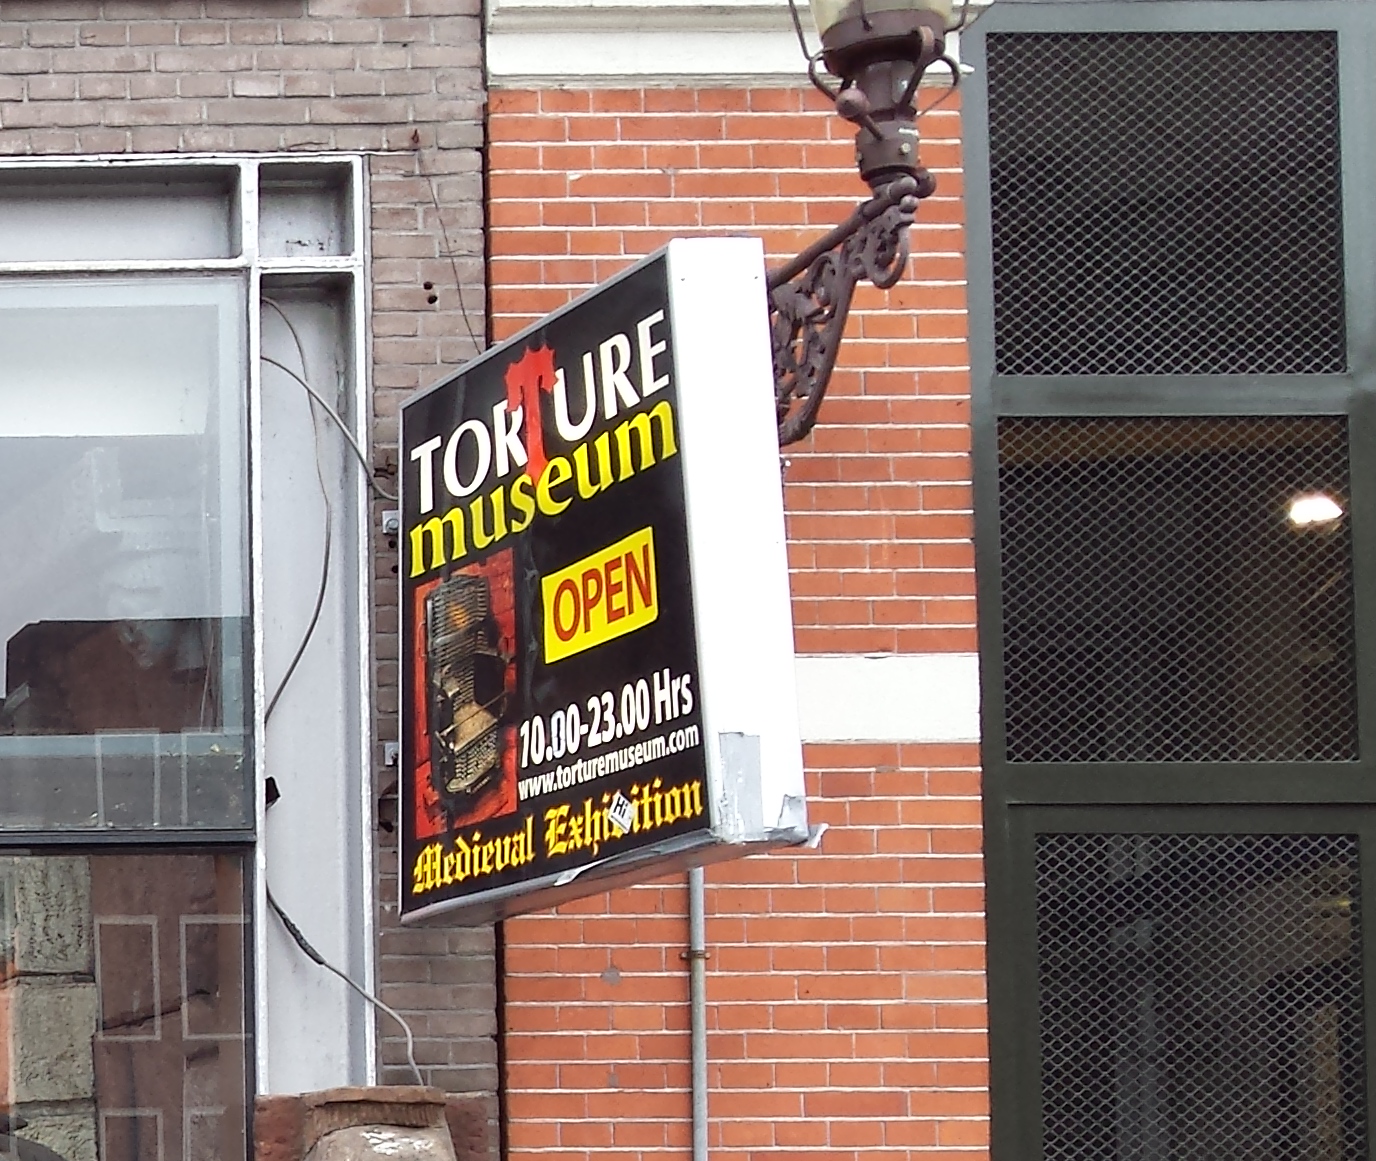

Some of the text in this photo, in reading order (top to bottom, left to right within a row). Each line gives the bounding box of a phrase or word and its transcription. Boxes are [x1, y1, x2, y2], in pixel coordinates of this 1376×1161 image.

[411, 309, 672, 515] TORTURE
[409, 399, 679, 578] museum
[552, 543, 652, 642] OPEN
[518, 667, 694, 770] 10.00-23.00 Hrs
[518, 724, 700, 802] www.torturemuseum.com
[412, 776, 704, 894] Medieval Exhiition
